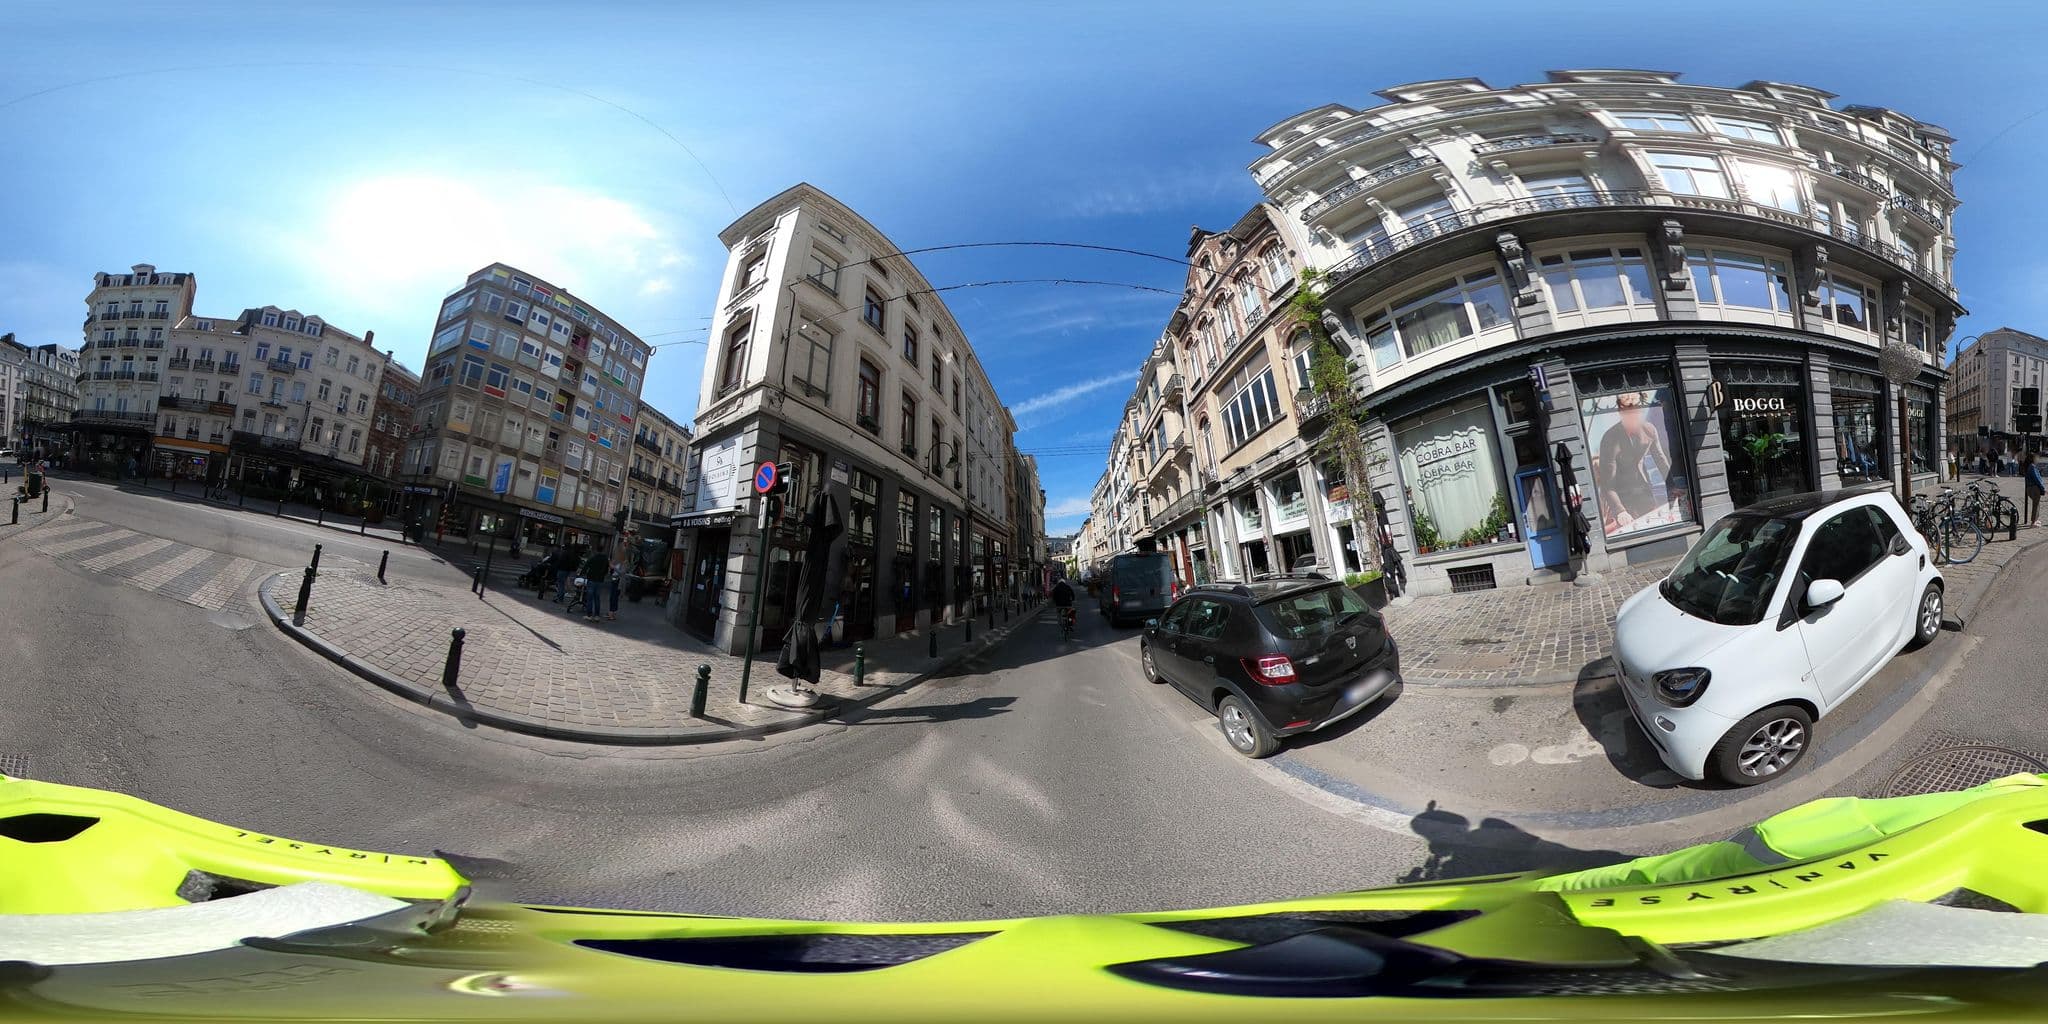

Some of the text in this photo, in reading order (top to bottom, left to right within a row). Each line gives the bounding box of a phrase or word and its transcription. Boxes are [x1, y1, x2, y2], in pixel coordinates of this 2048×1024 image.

[1712, 381, 1724, 407] B
[1733, 398, 1785, 411] BOGGI
[1416, 438, 1476, 463] COBRA BAR
[1454, 460, 1475, 471] BAR
